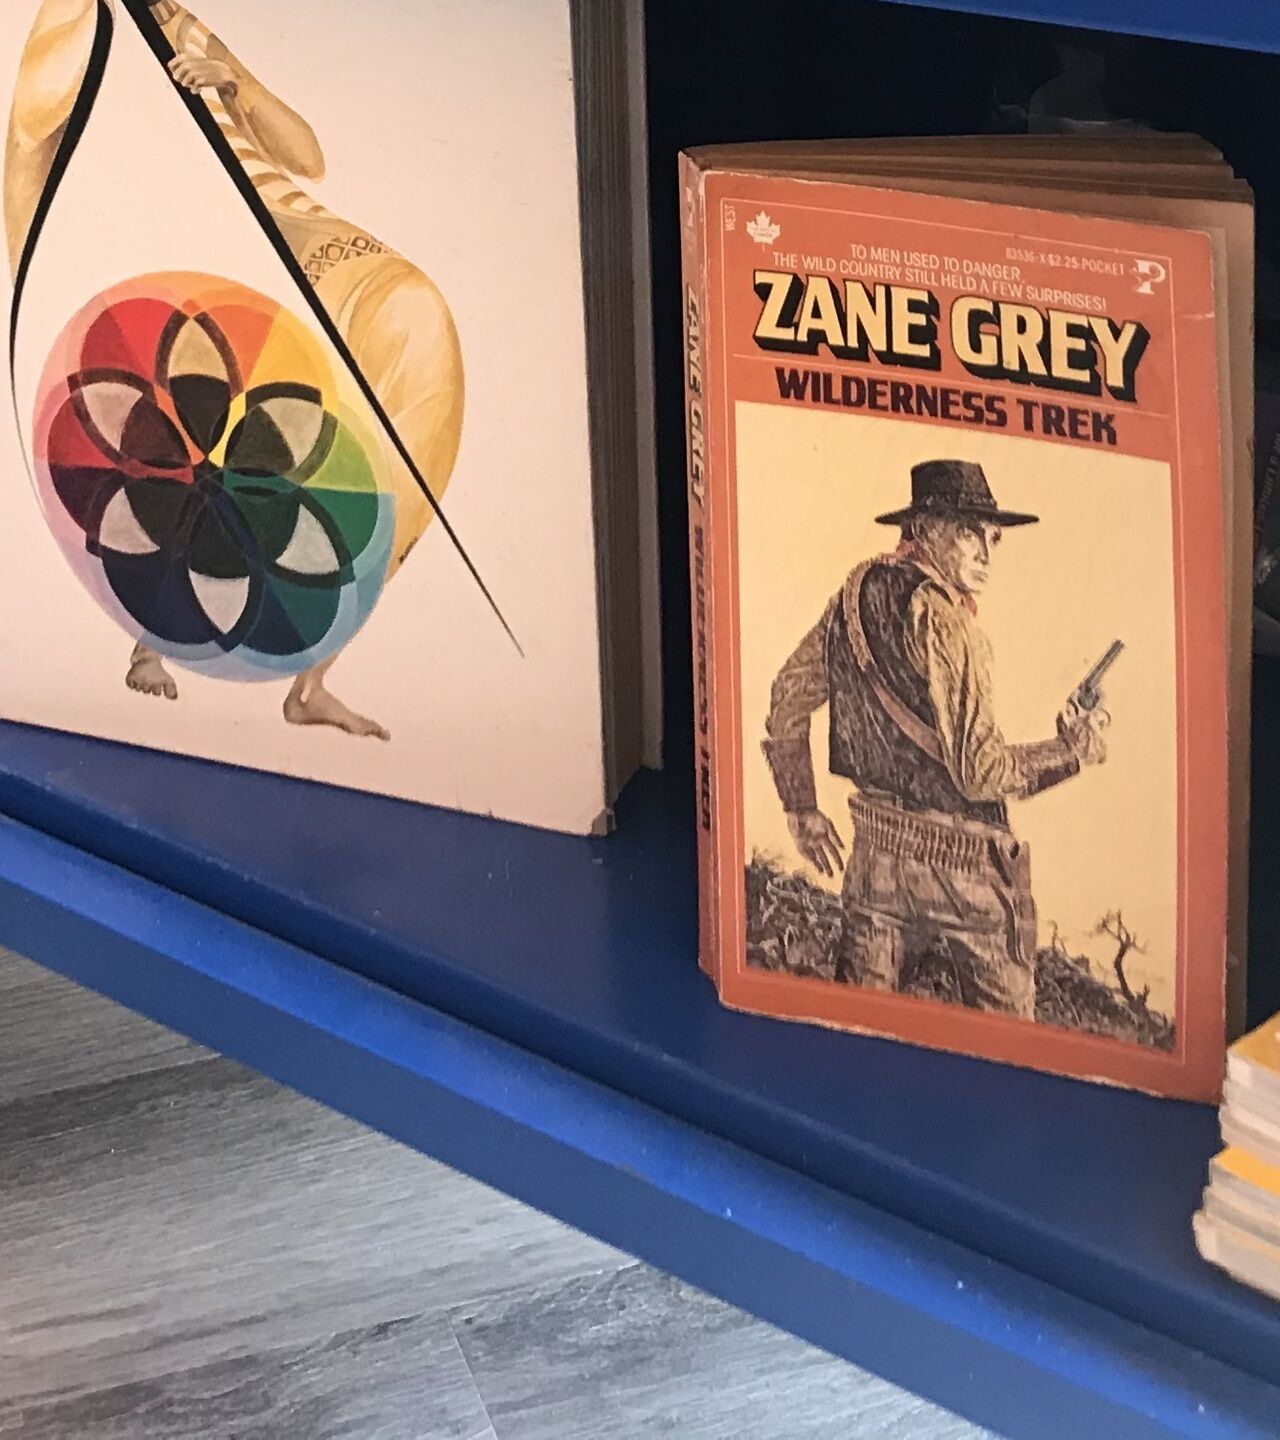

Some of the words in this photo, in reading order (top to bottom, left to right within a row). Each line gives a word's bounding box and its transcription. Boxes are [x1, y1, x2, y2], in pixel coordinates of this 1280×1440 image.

[724, 203, 736, 232] WEST
[773, 251, 798, 268] THE
[801, 255, 836, 272] WILD
[839, 260, 901, 280] COUNTRY
[905, 268, 938, 286] STILL
[941, 273, 977, 291] HELD
[978, 279, 990, 294] A
[992, 281, 1023, 298] FEW
[1026, 284, 1107, 311] SURPRISES!
[850, 243, 867, 260] TO
[870, 246, 901, 263] MEN
[904, 251, 939, 270] USED
[943, 256, 960, 273] TO
[1081, 257, 1125, 276] POCKET
[686, 282, 703, 394] ZANE
[752, 269, 941, 370] ZANE
[949, 295, 1151, 403] GREY
[775, 366, 1009, 427] WILDERNESS
[1016, 397, 1118, 445] TREK
[688, 402, 707, 510] GREY
